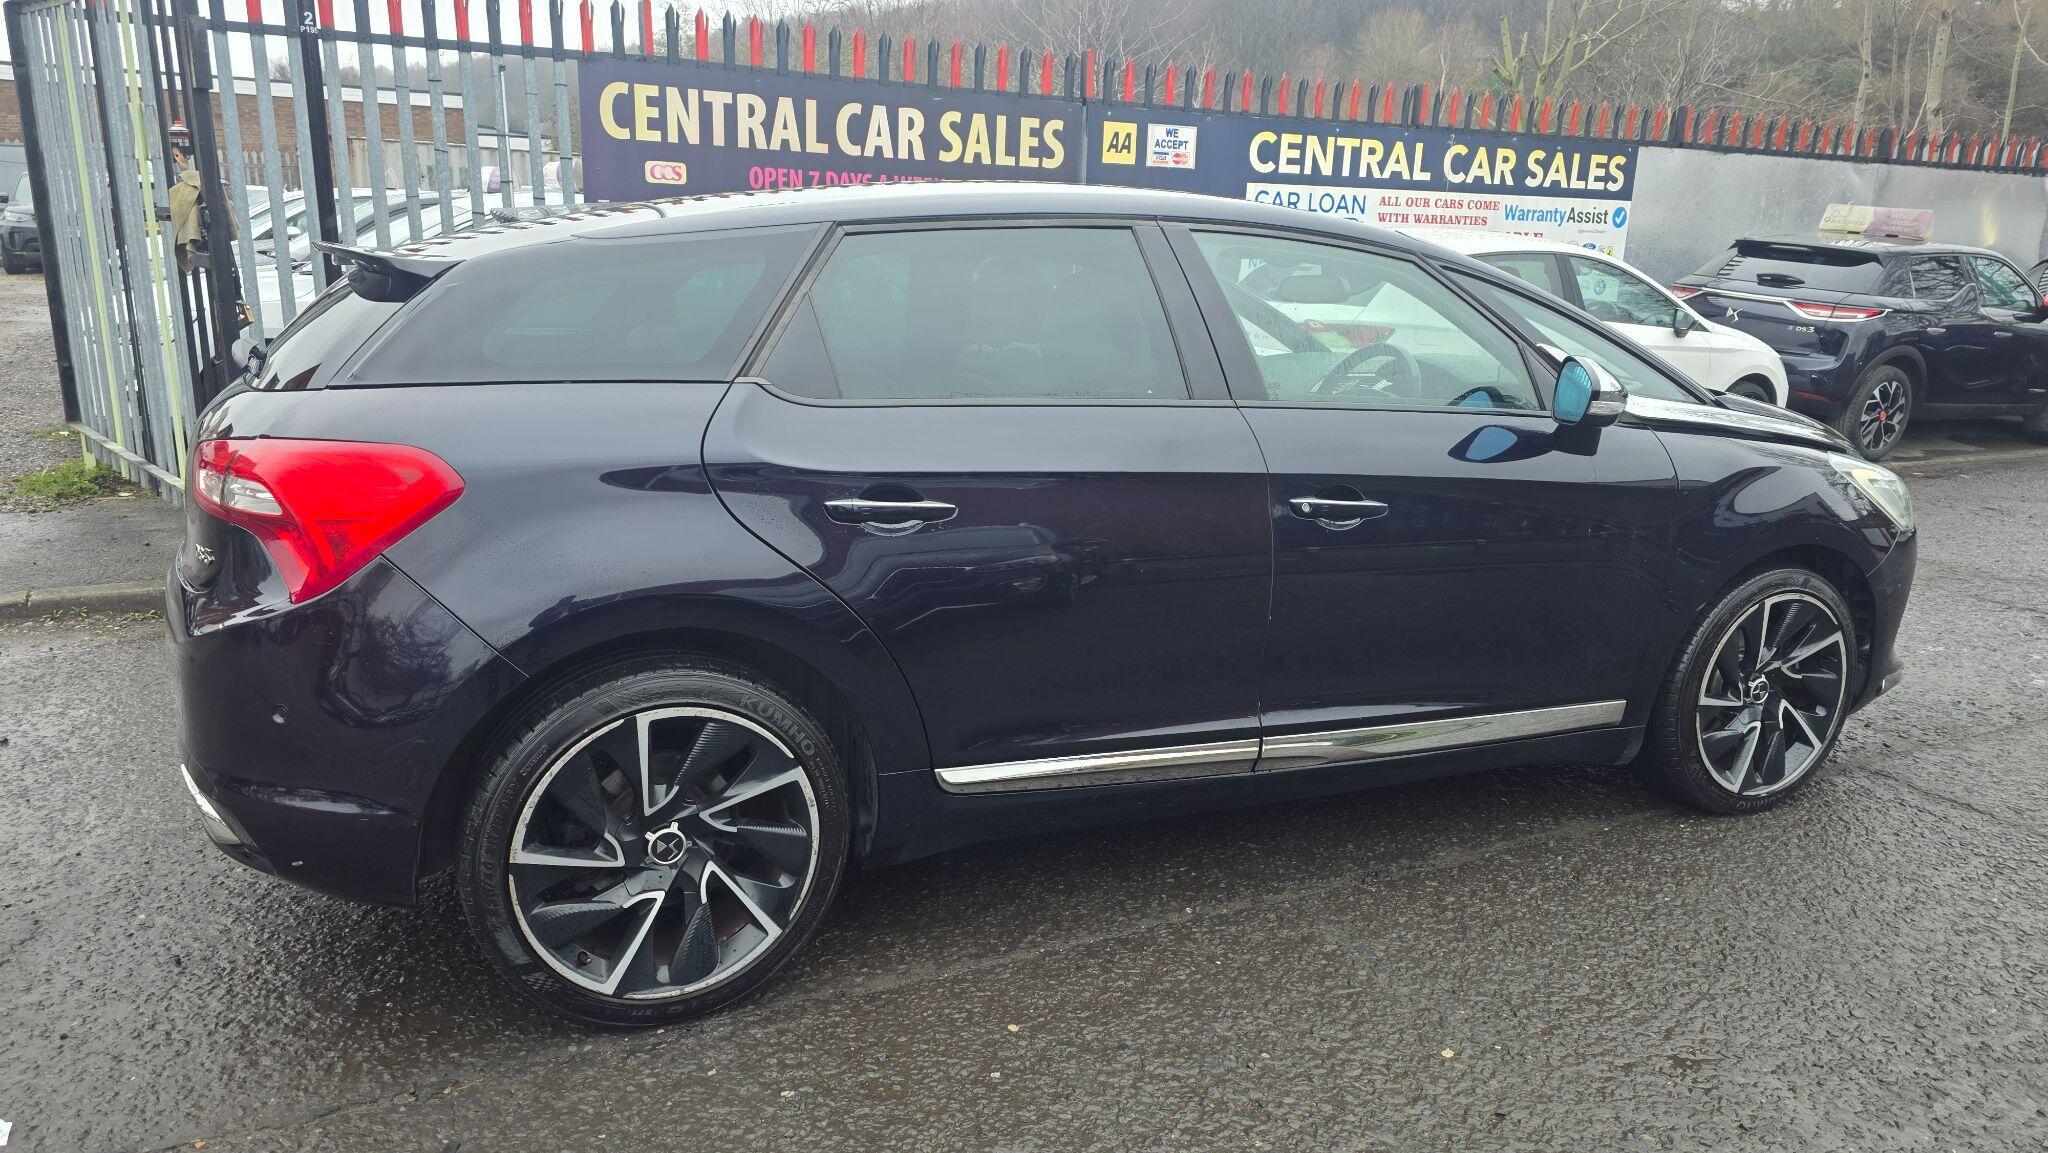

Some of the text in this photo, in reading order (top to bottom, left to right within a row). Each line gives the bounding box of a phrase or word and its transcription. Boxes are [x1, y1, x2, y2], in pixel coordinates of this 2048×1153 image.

[303, 11, 314, 25] 2
[599, 81, 1065, 169] CENTRAL CAR SALES
[1165, 127, 1180, 138] WE
[1106, 131, 1132, 154] AA
[1154, 139, 1189, 150] ACCEPT
[1249, 131, 1627, 192] CENTRAL CAR SALES
[749, 166, 803, 190] OPEN
[809, 170, 820, 187] 7
[1254, 189, 1367, 214] CAR LOAN
[1378, 195, 1500, 211] ALL OUR CARS COME
[1377, 212, 1410, 224] WITH
[1413, 213, 1488, 227] WARRANTIES
[740, 695, 816, 756] KUMHO
